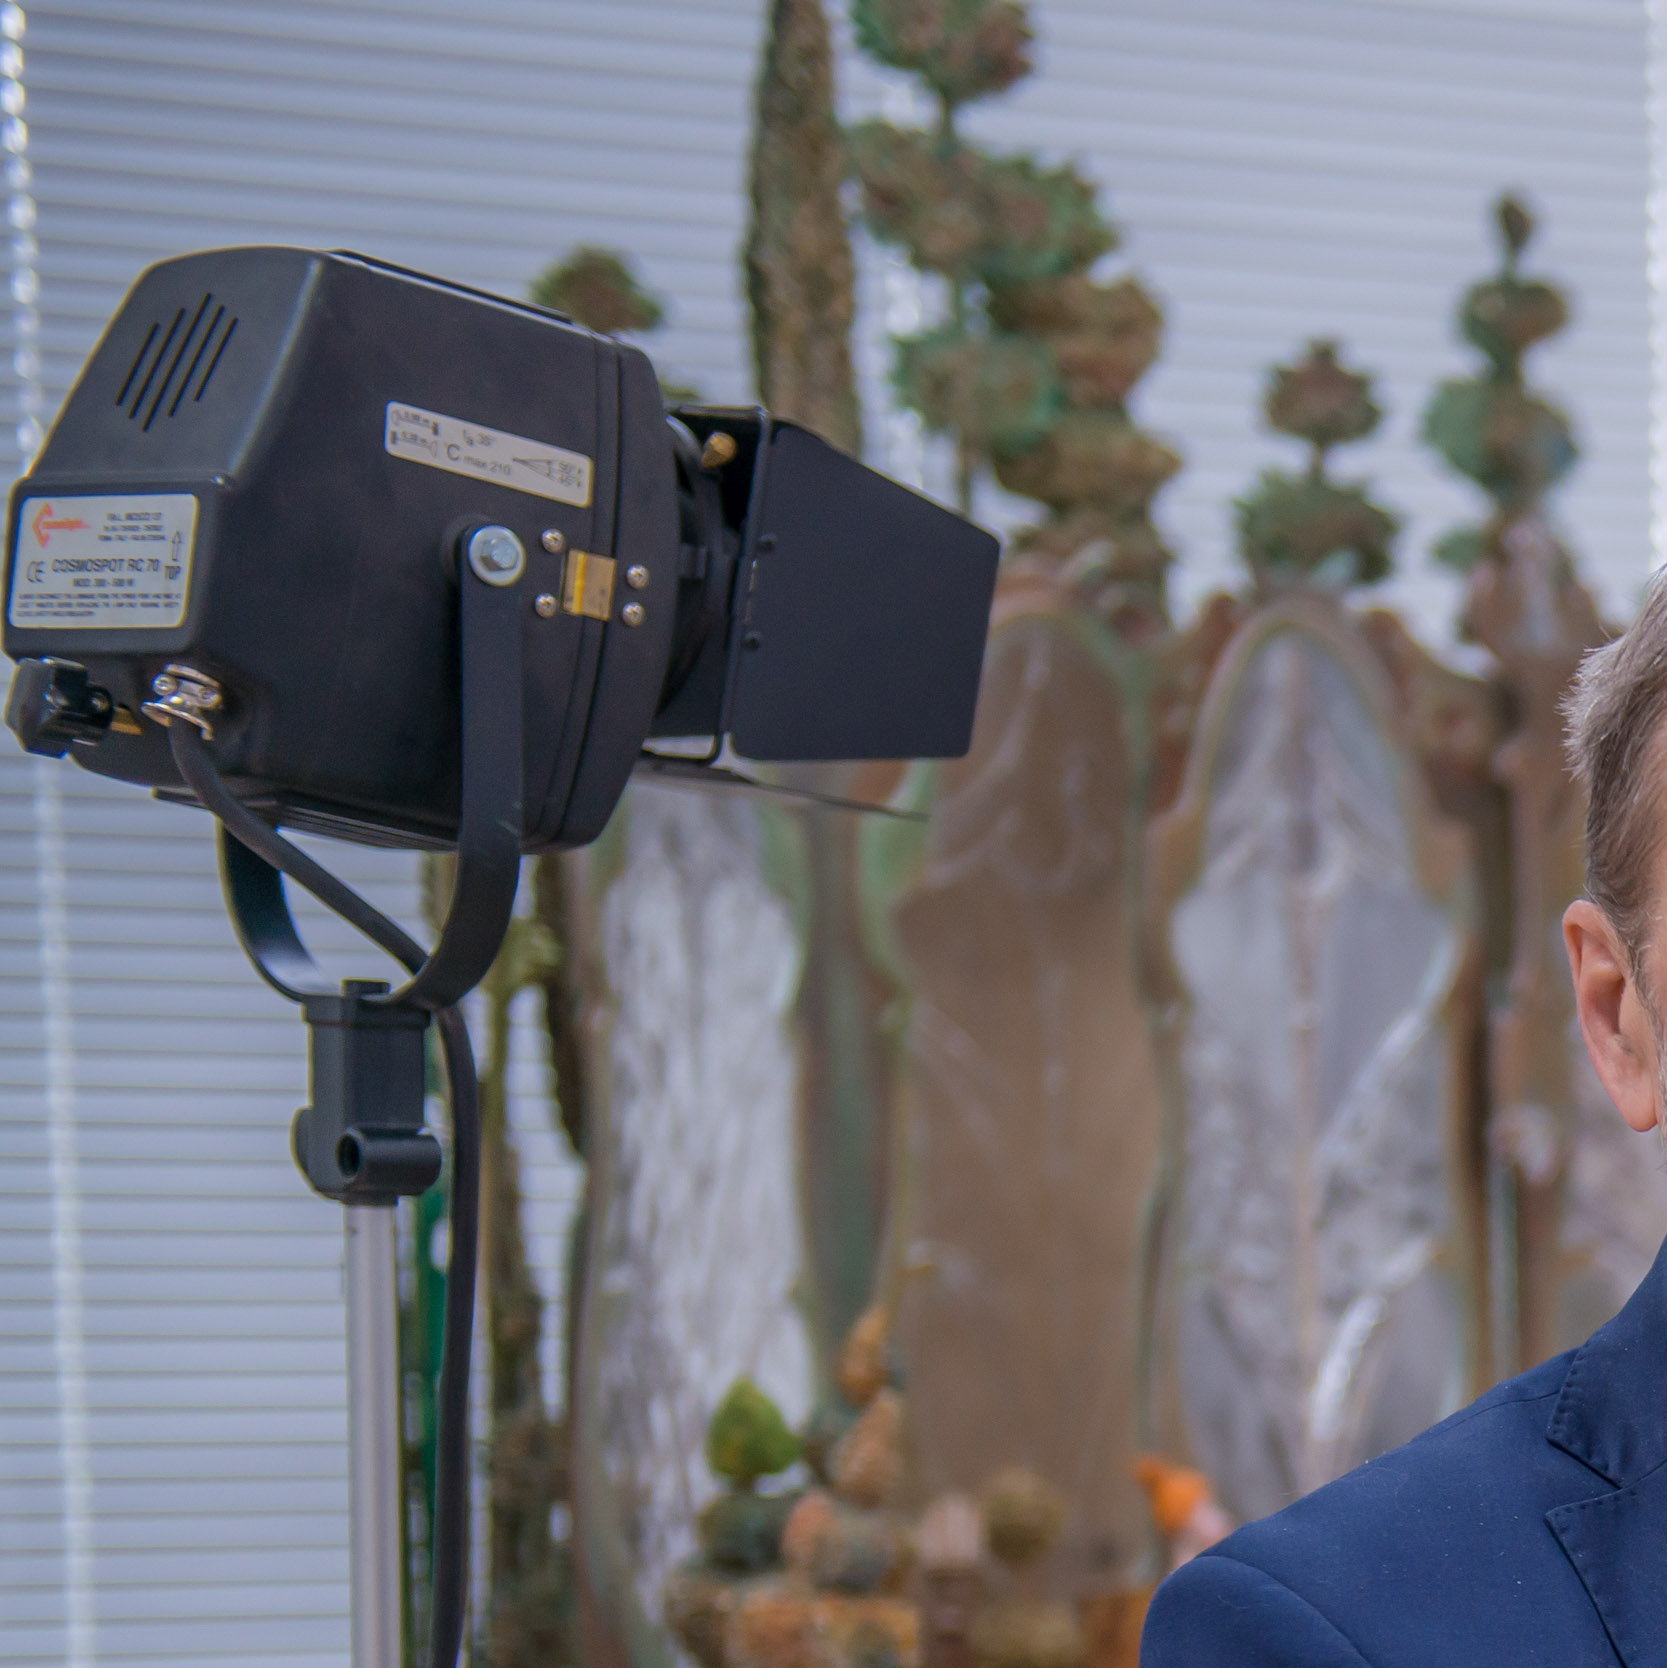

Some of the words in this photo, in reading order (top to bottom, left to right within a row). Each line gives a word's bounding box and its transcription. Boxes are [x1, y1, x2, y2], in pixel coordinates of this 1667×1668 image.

[488, 461, 511, 476] 210
[51, 558, 125, 573] COSMOSPOT
[126, 558, 145, 572] RC
[146, 558, 161, 572] 70
[164, 565, 182, 580] TOP
